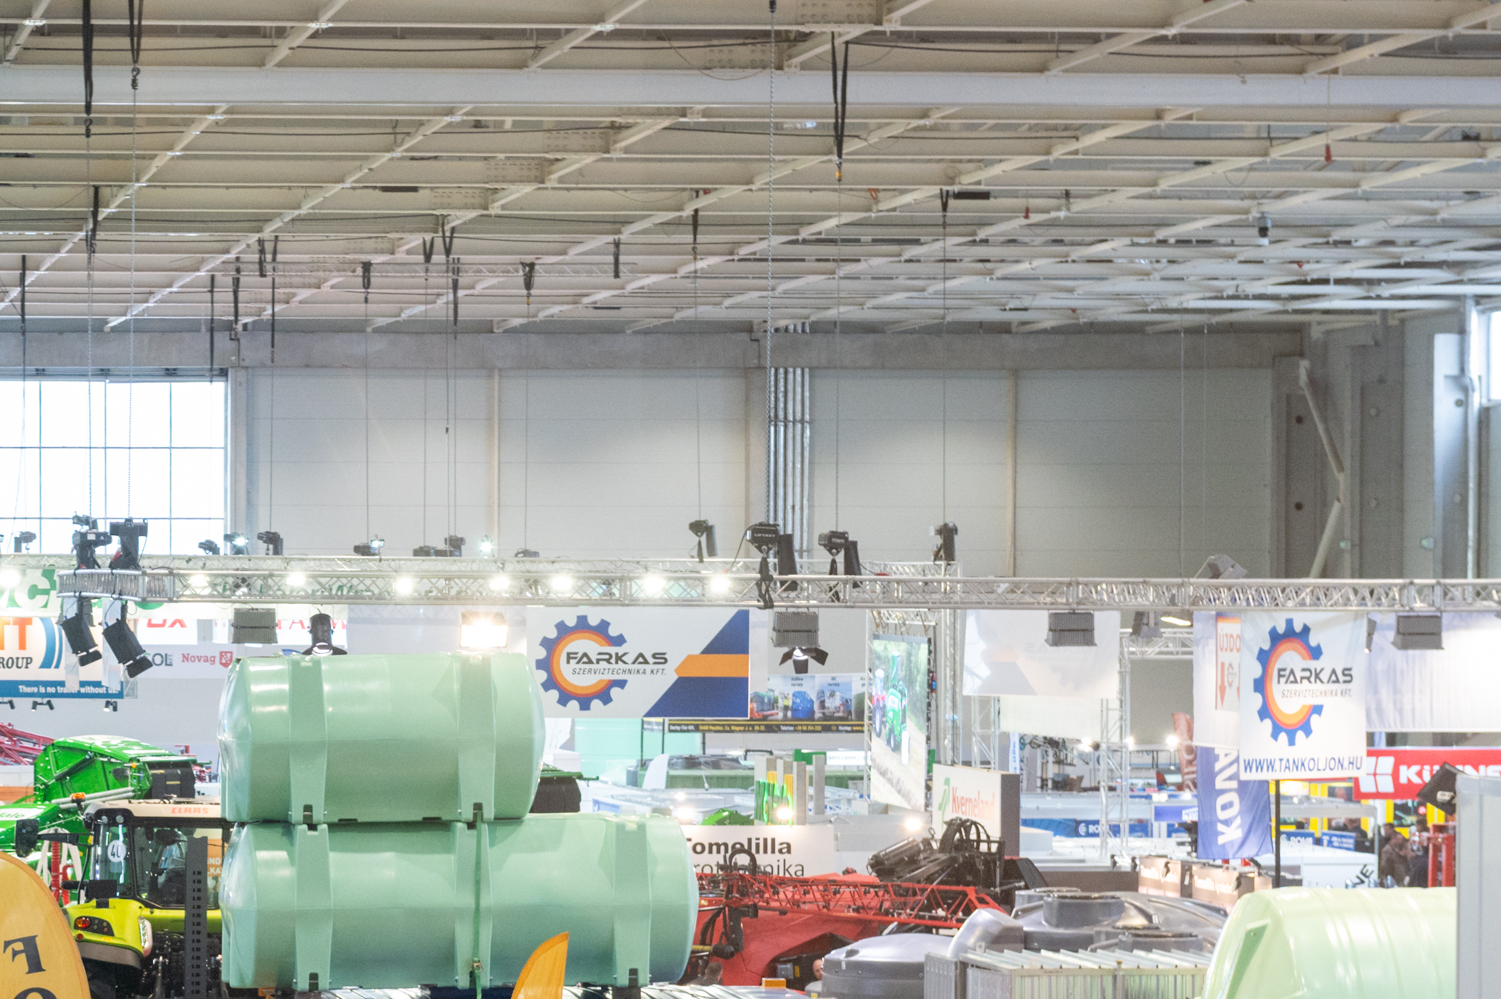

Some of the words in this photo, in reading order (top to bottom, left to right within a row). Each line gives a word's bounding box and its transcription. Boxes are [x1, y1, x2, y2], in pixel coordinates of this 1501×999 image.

[1219, 630, 1241, 653] ÚJDO
[181, 652, 216, 666] Novag
[566, 651, 668, 665] FARKAS
[572, 667, 647, 676] SZERVIZTECHNIKA
[650, 668, 667, 676] KFT.
[1276, 667, 1354, 685] FARKAS
[18, 685, 39, 694] There
[40, 686, 46, 694] is
[1243, 755, 1364, 774] WWW.TANKOLJON.HU
[951, 786, 996, 819] Kverneland
[171, 807, 209, 815] CLAAS
[110, 844, 122, 858] 40
